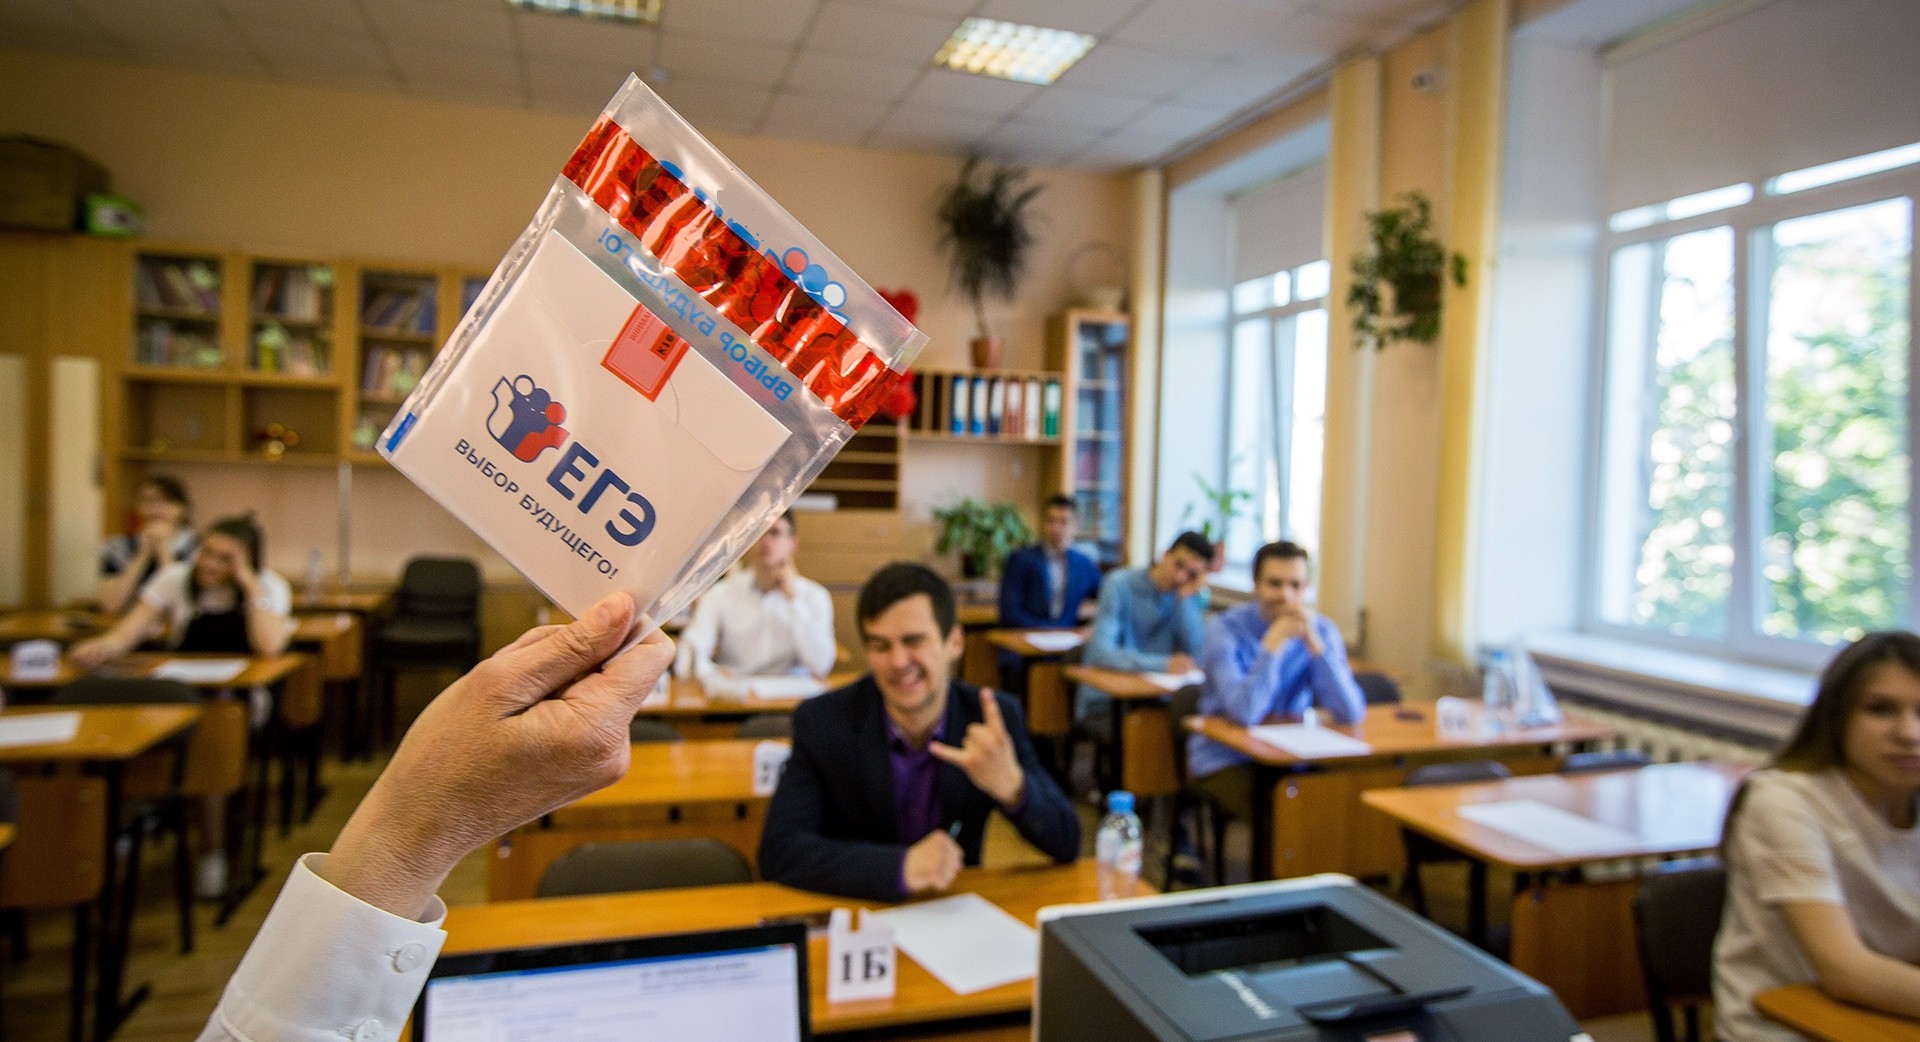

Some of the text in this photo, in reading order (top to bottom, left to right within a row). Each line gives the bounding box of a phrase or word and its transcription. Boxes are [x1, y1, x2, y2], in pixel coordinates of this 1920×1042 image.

[455, 438, 619, 579] ВЫБОР БУДУЩЕГО!
[547, 441, 656, 547] ЕГЭ
[842, 947, 887, 983] 1Б
